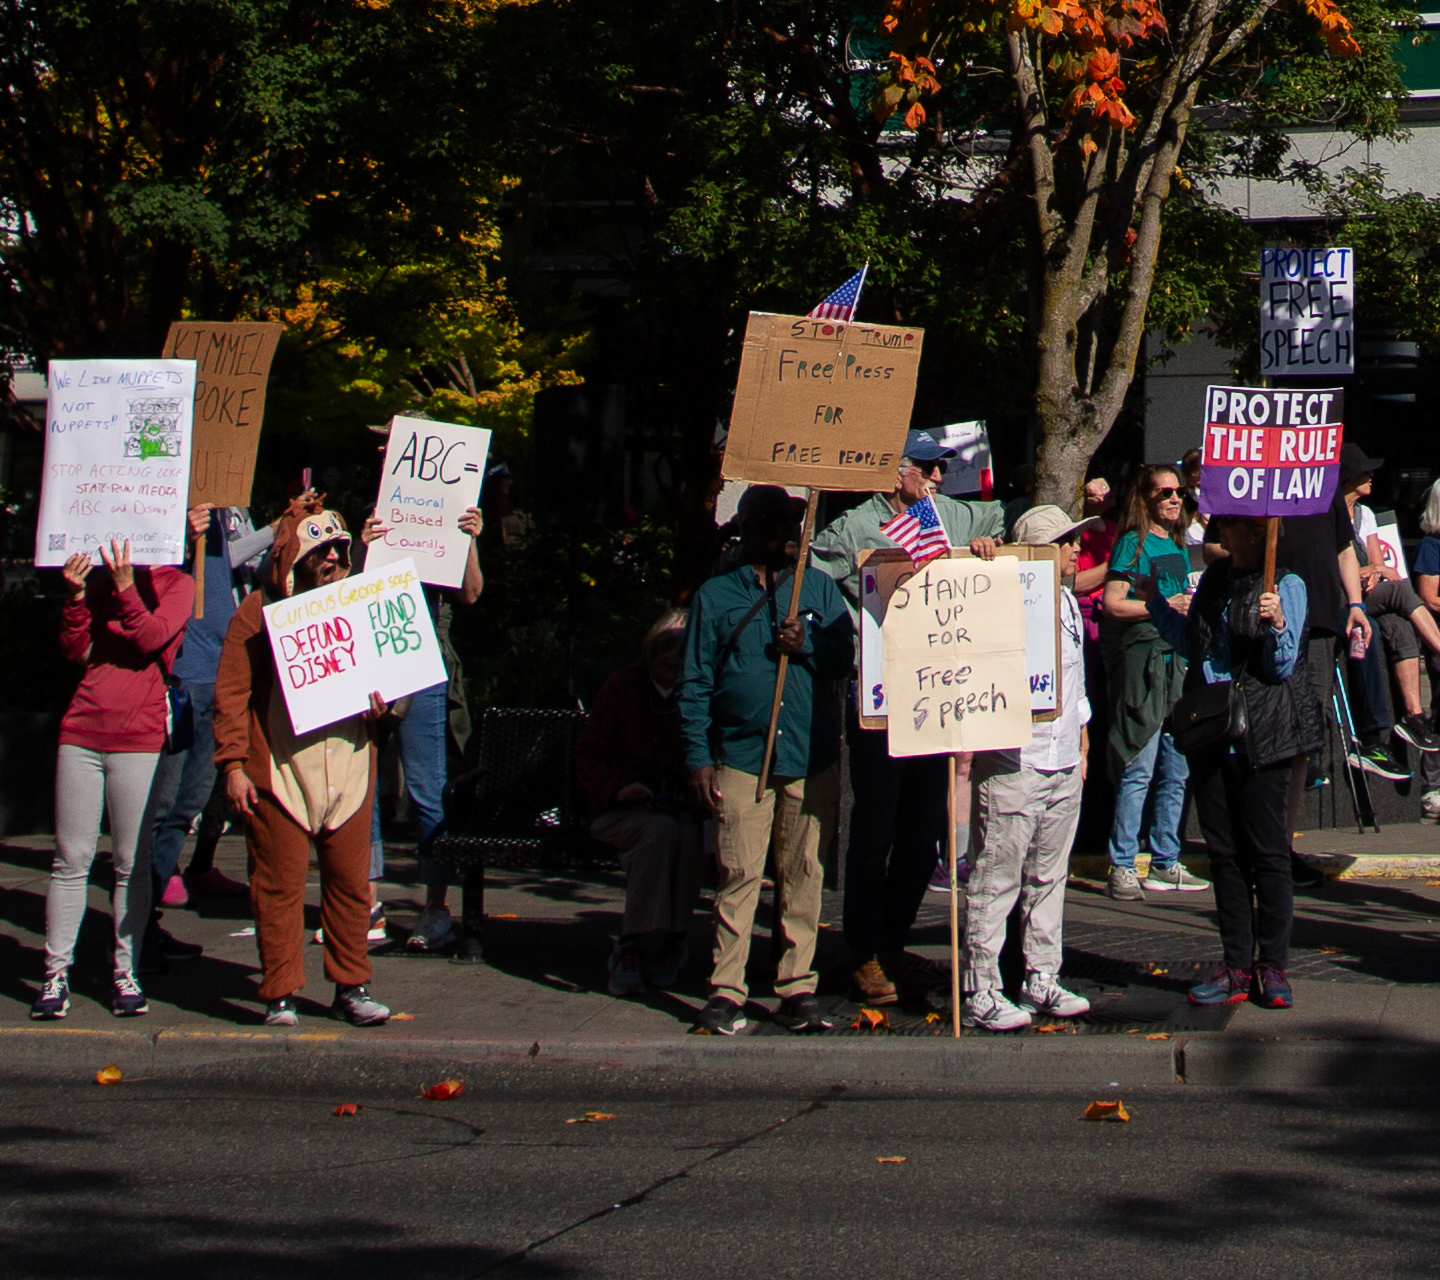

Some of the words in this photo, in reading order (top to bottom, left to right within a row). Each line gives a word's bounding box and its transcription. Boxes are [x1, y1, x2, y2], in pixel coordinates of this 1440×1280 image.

[1260, 247, 1352, 278] PROTECT
[1269, 279, 1350, 321] FREE
[790, 319, 846, 341] STOP
[860, 329, 915, 347] TRUMP
[1260, 327, 1351, 369] SPEECH
[171, 327, 265, 377] KIMMEL
[117, 369, 184, 387] MUPPETS
[61, 401, 96, 414] NOT
[195, 380, 258, 428] POKE
[813, 404, 845, 426] FOR
[1209, 389, 1335, 426] PROTECT
[771, 441, 823, 464] FREE
[838, 449, 895, 467] PEOPLE
[1209, 426, 1266, 462] THE
[1278, 427, 1339, 464] RULE
[50, 463, 84, 480] STOP
[89, 463, 153, 480] ACTING
[195, 448, 247, 499] UTH
[1227, 466, 1266, 501] OF
[1271, 465, 1326, 501] LAW
[68, 498, 103, 517] ABC
[389, 488, 446, 511] Amoral
[389, 507, 444, 528] Biased
[382, 528, 447, 559] Cowardly
[270, 596, 338, 630] Curious
[337, 576, 388, 609] George
[367, 592, 417, 632] FUND
[934, 604, 964, 628] UP
[279, 614, 354, 663] DEFUND
[373, 620, 423, 659] PBS
[927, 626, 972, 649] FOR
[287, 640, 358, 691] DISNEY
[915, 664, 973, 693] Free
[911, 682, 1008, 733] Speech
